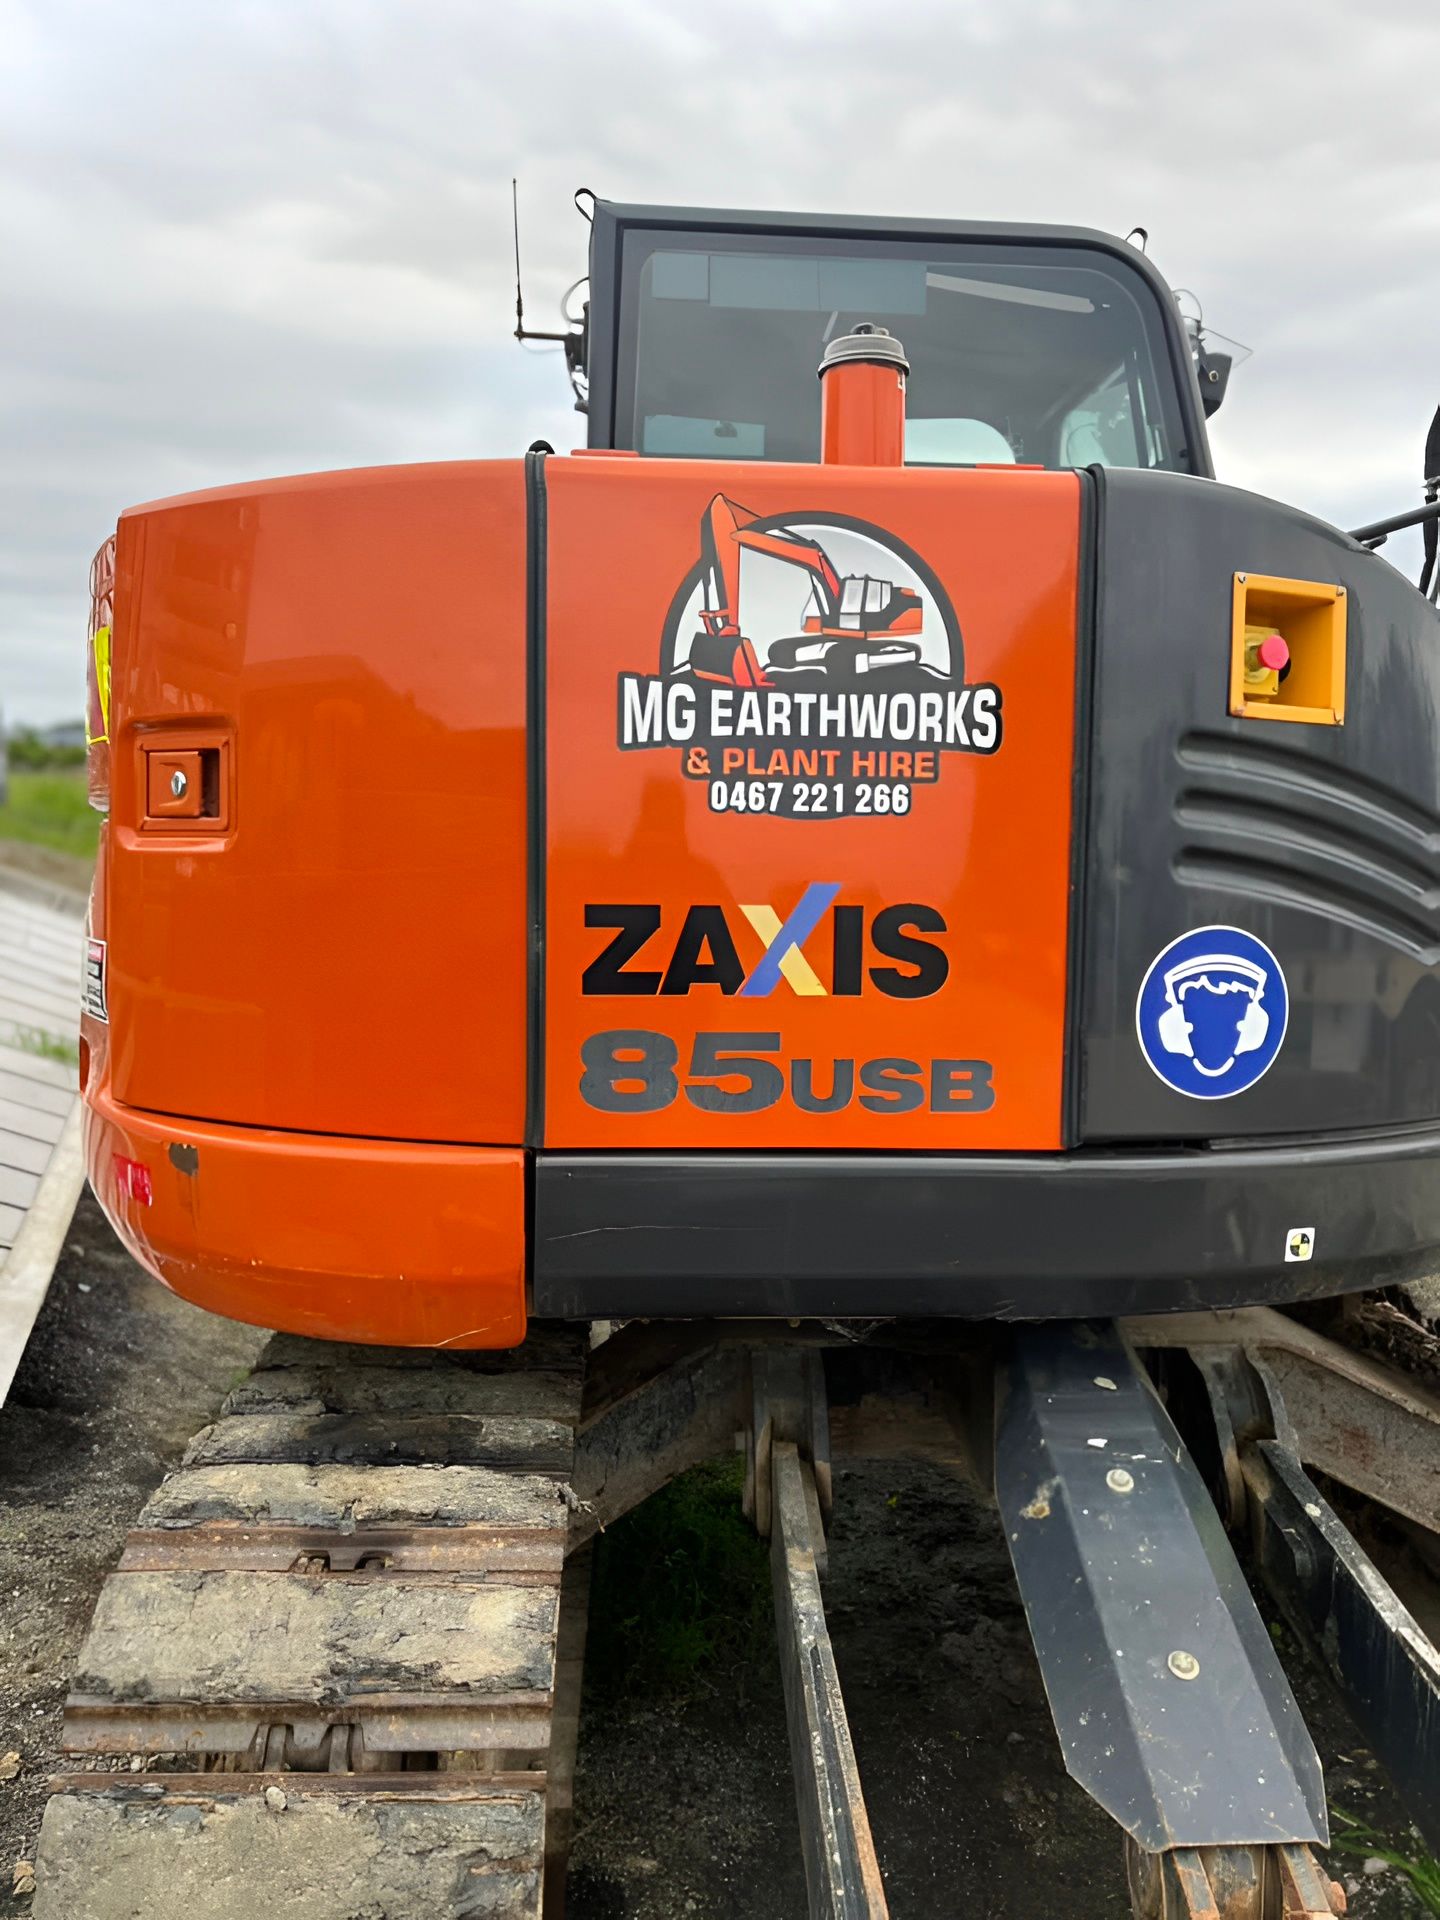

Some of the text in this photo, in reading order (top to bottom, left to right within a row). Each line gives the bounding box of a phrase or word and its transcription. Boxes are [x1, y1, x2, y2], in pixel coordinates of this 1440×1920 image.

[623, 677, 997, 749] MG EARTHWORKS
[687, 747, 935, 778] & PLANT HIRE
[711, 781, 909, 814] 0467 221 266
[582, 882, 949, 999] ZAXIS
